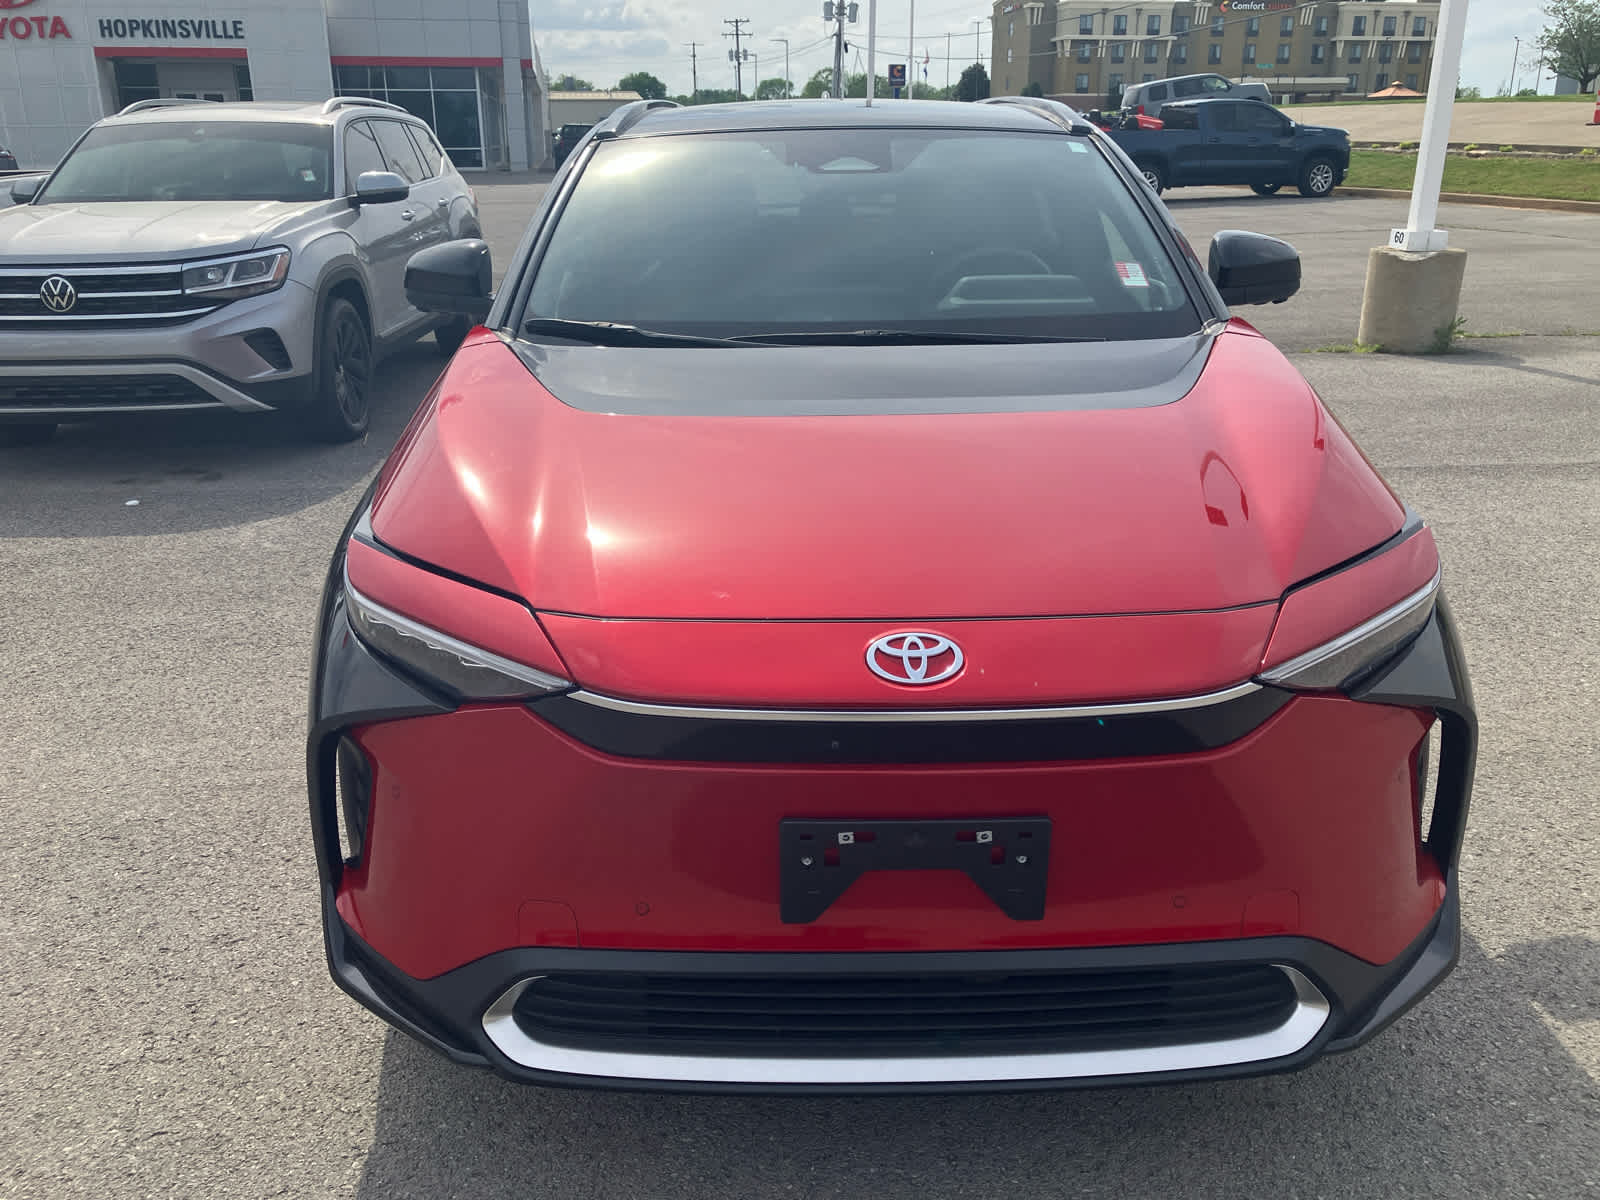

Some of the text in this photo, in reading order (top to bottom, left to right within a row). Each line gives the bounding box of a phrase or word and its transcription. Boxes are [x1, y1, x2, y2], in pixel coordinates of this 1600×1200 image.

[1231, 1, 1264, 10] Comfort
[98, 18, 245, 39] HOPKINSVILLE
[1394, 231, 1405, 244] 60
